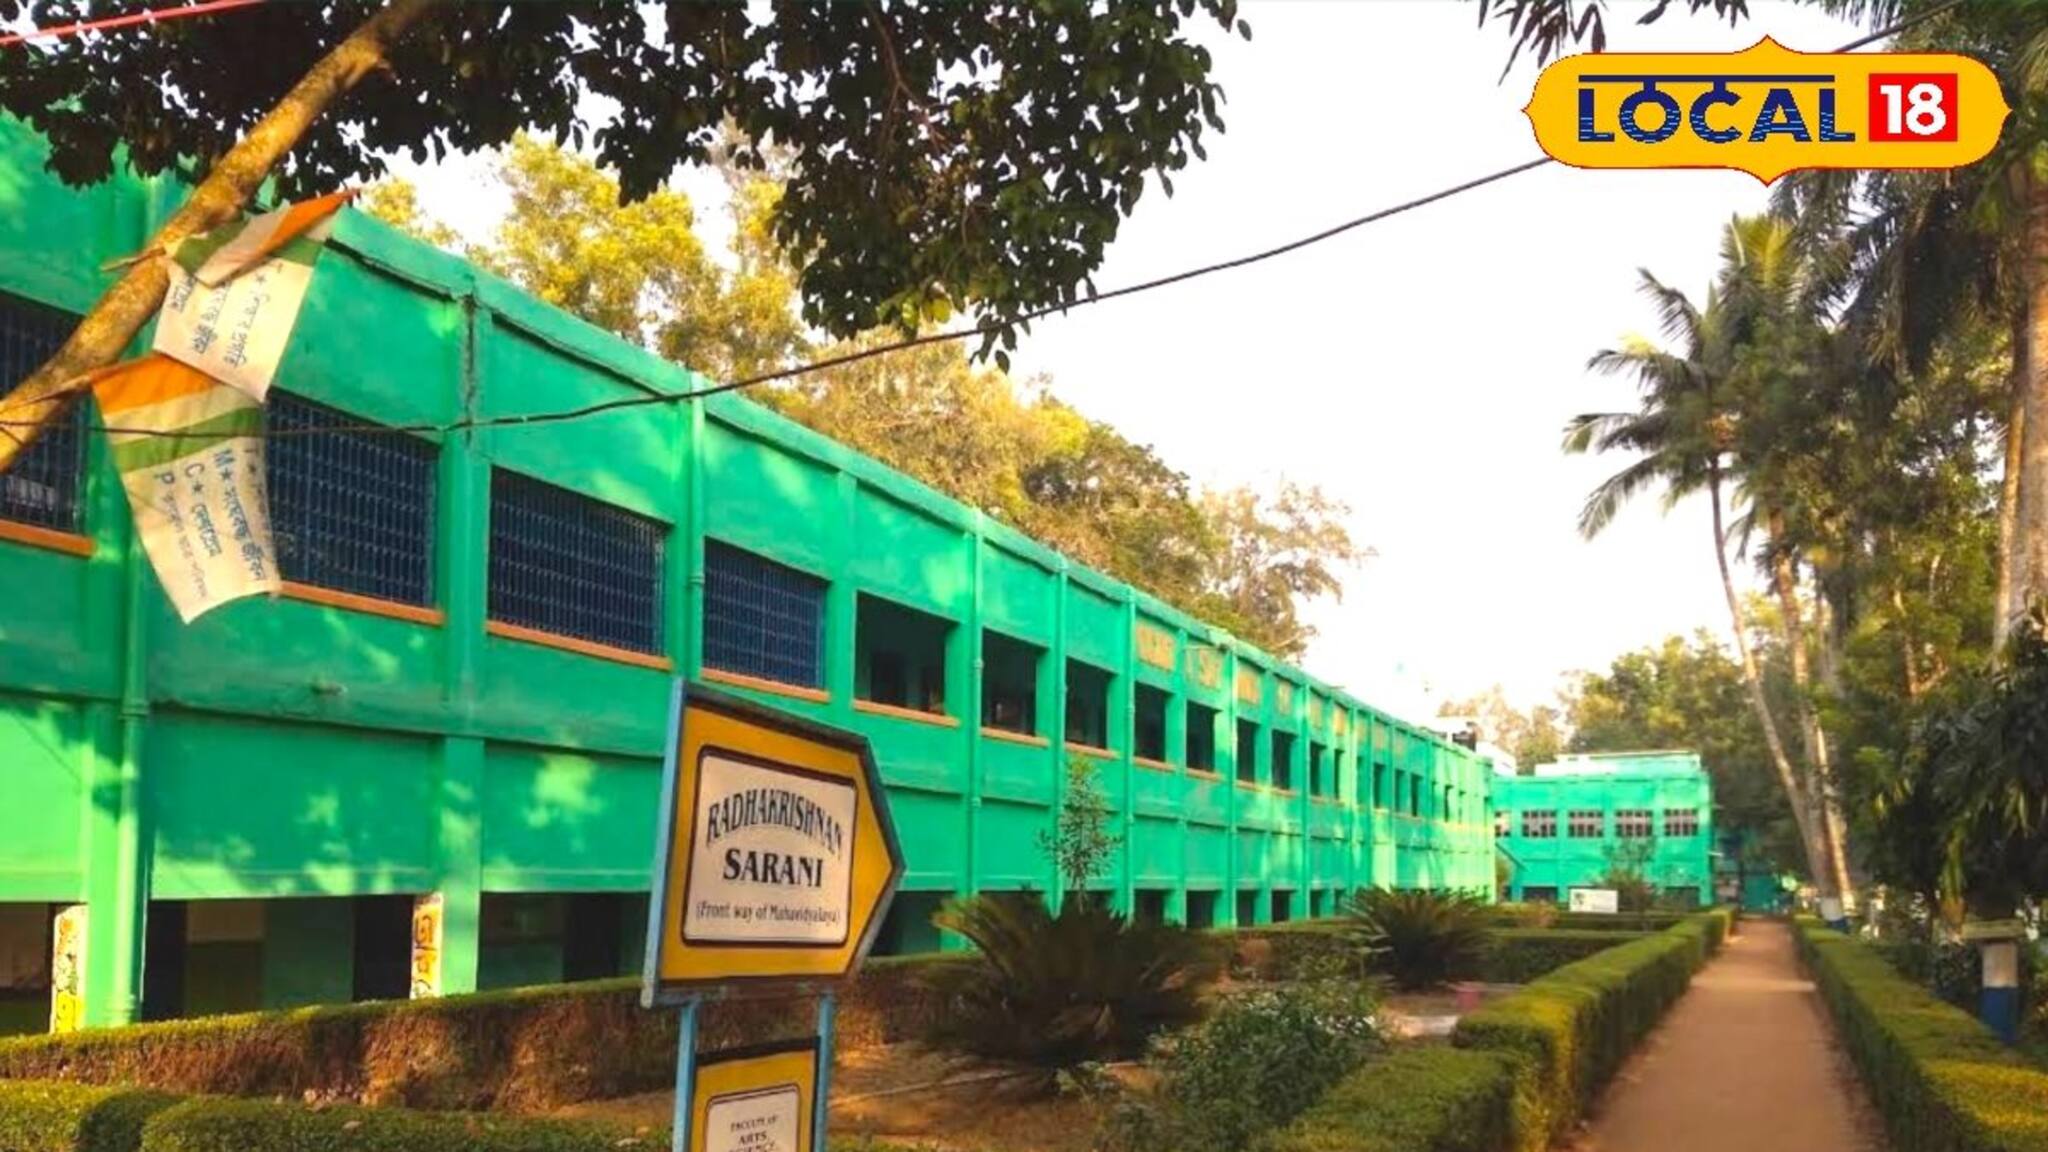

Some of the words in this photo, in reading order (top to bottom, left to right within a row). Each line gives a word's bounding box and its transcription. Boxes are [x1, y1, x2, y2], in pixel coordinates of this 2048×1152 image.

[214, 449, 236, 468] M
[153, 471, 176, 484] P
[185, 463, 205, 478] C
[706, 788, 843, 860] RADHAKRISHNAN
[723, 847, 824, 888] SARANI
[696, 900, 731, 921] (Front
[734, 904, 752, 923] way
[755, 905, 768, 920] of
[768, 903, 841, 926] Mahavidyalaya)
